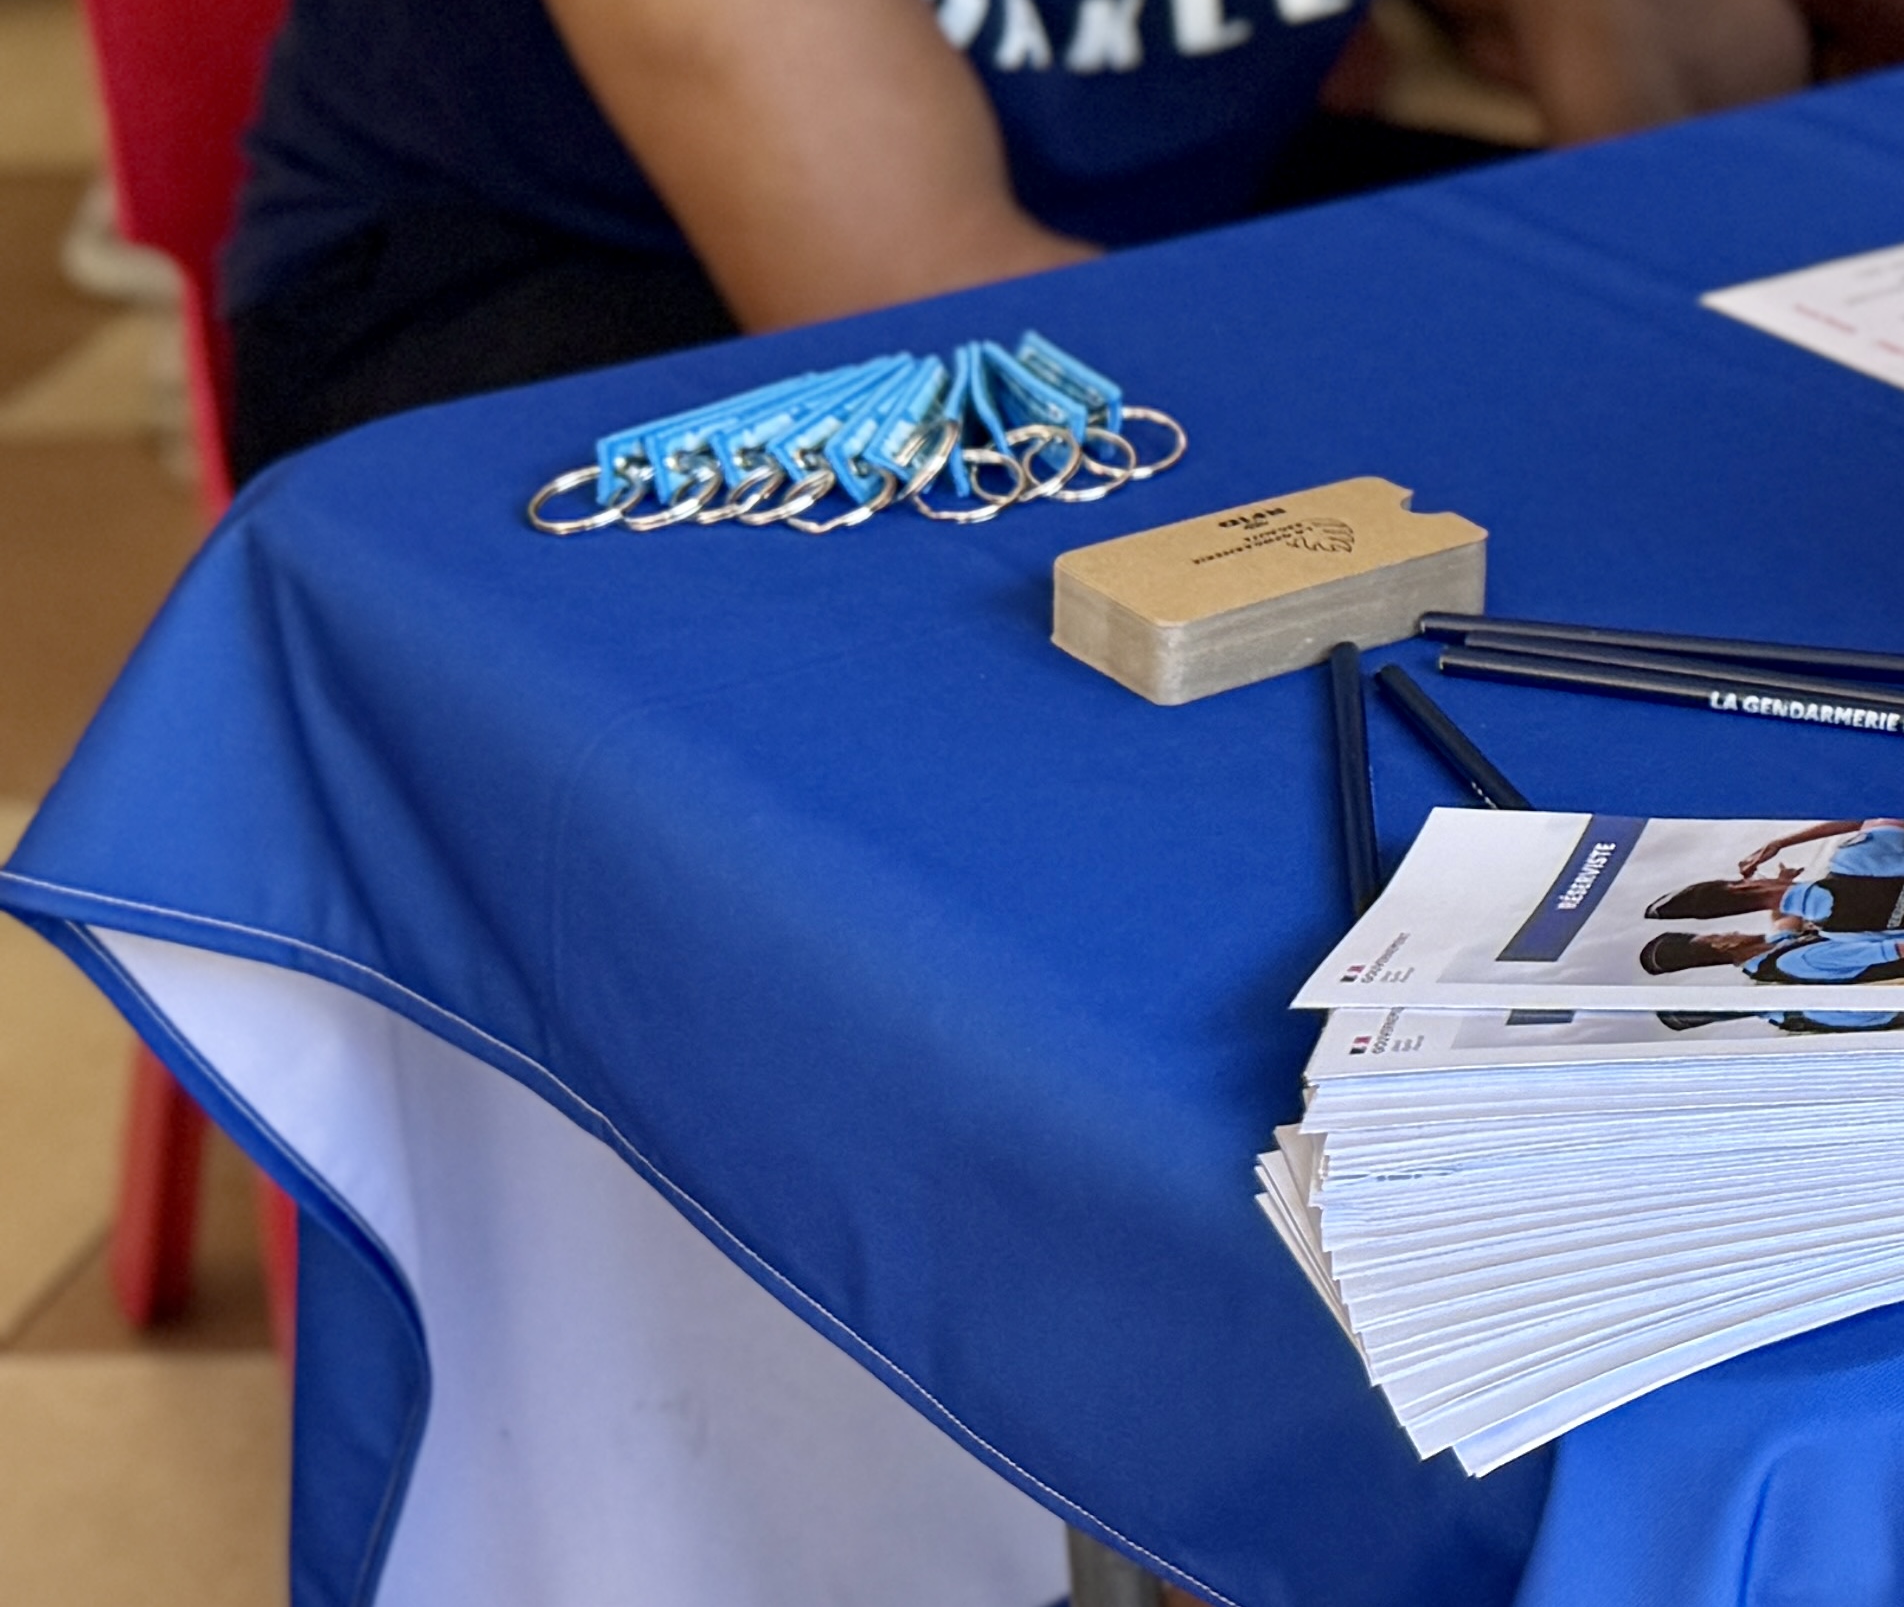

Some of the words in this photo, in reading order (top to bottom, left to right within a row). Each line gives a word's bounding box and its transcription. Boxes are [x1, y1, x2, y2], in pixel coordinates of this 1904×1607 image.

[1709, 691, 1738, 711] LA
[1742, 695, 1900, 732] GENDARMERIE
[1557, 842, 1617, 910] RÉSERVISTE
